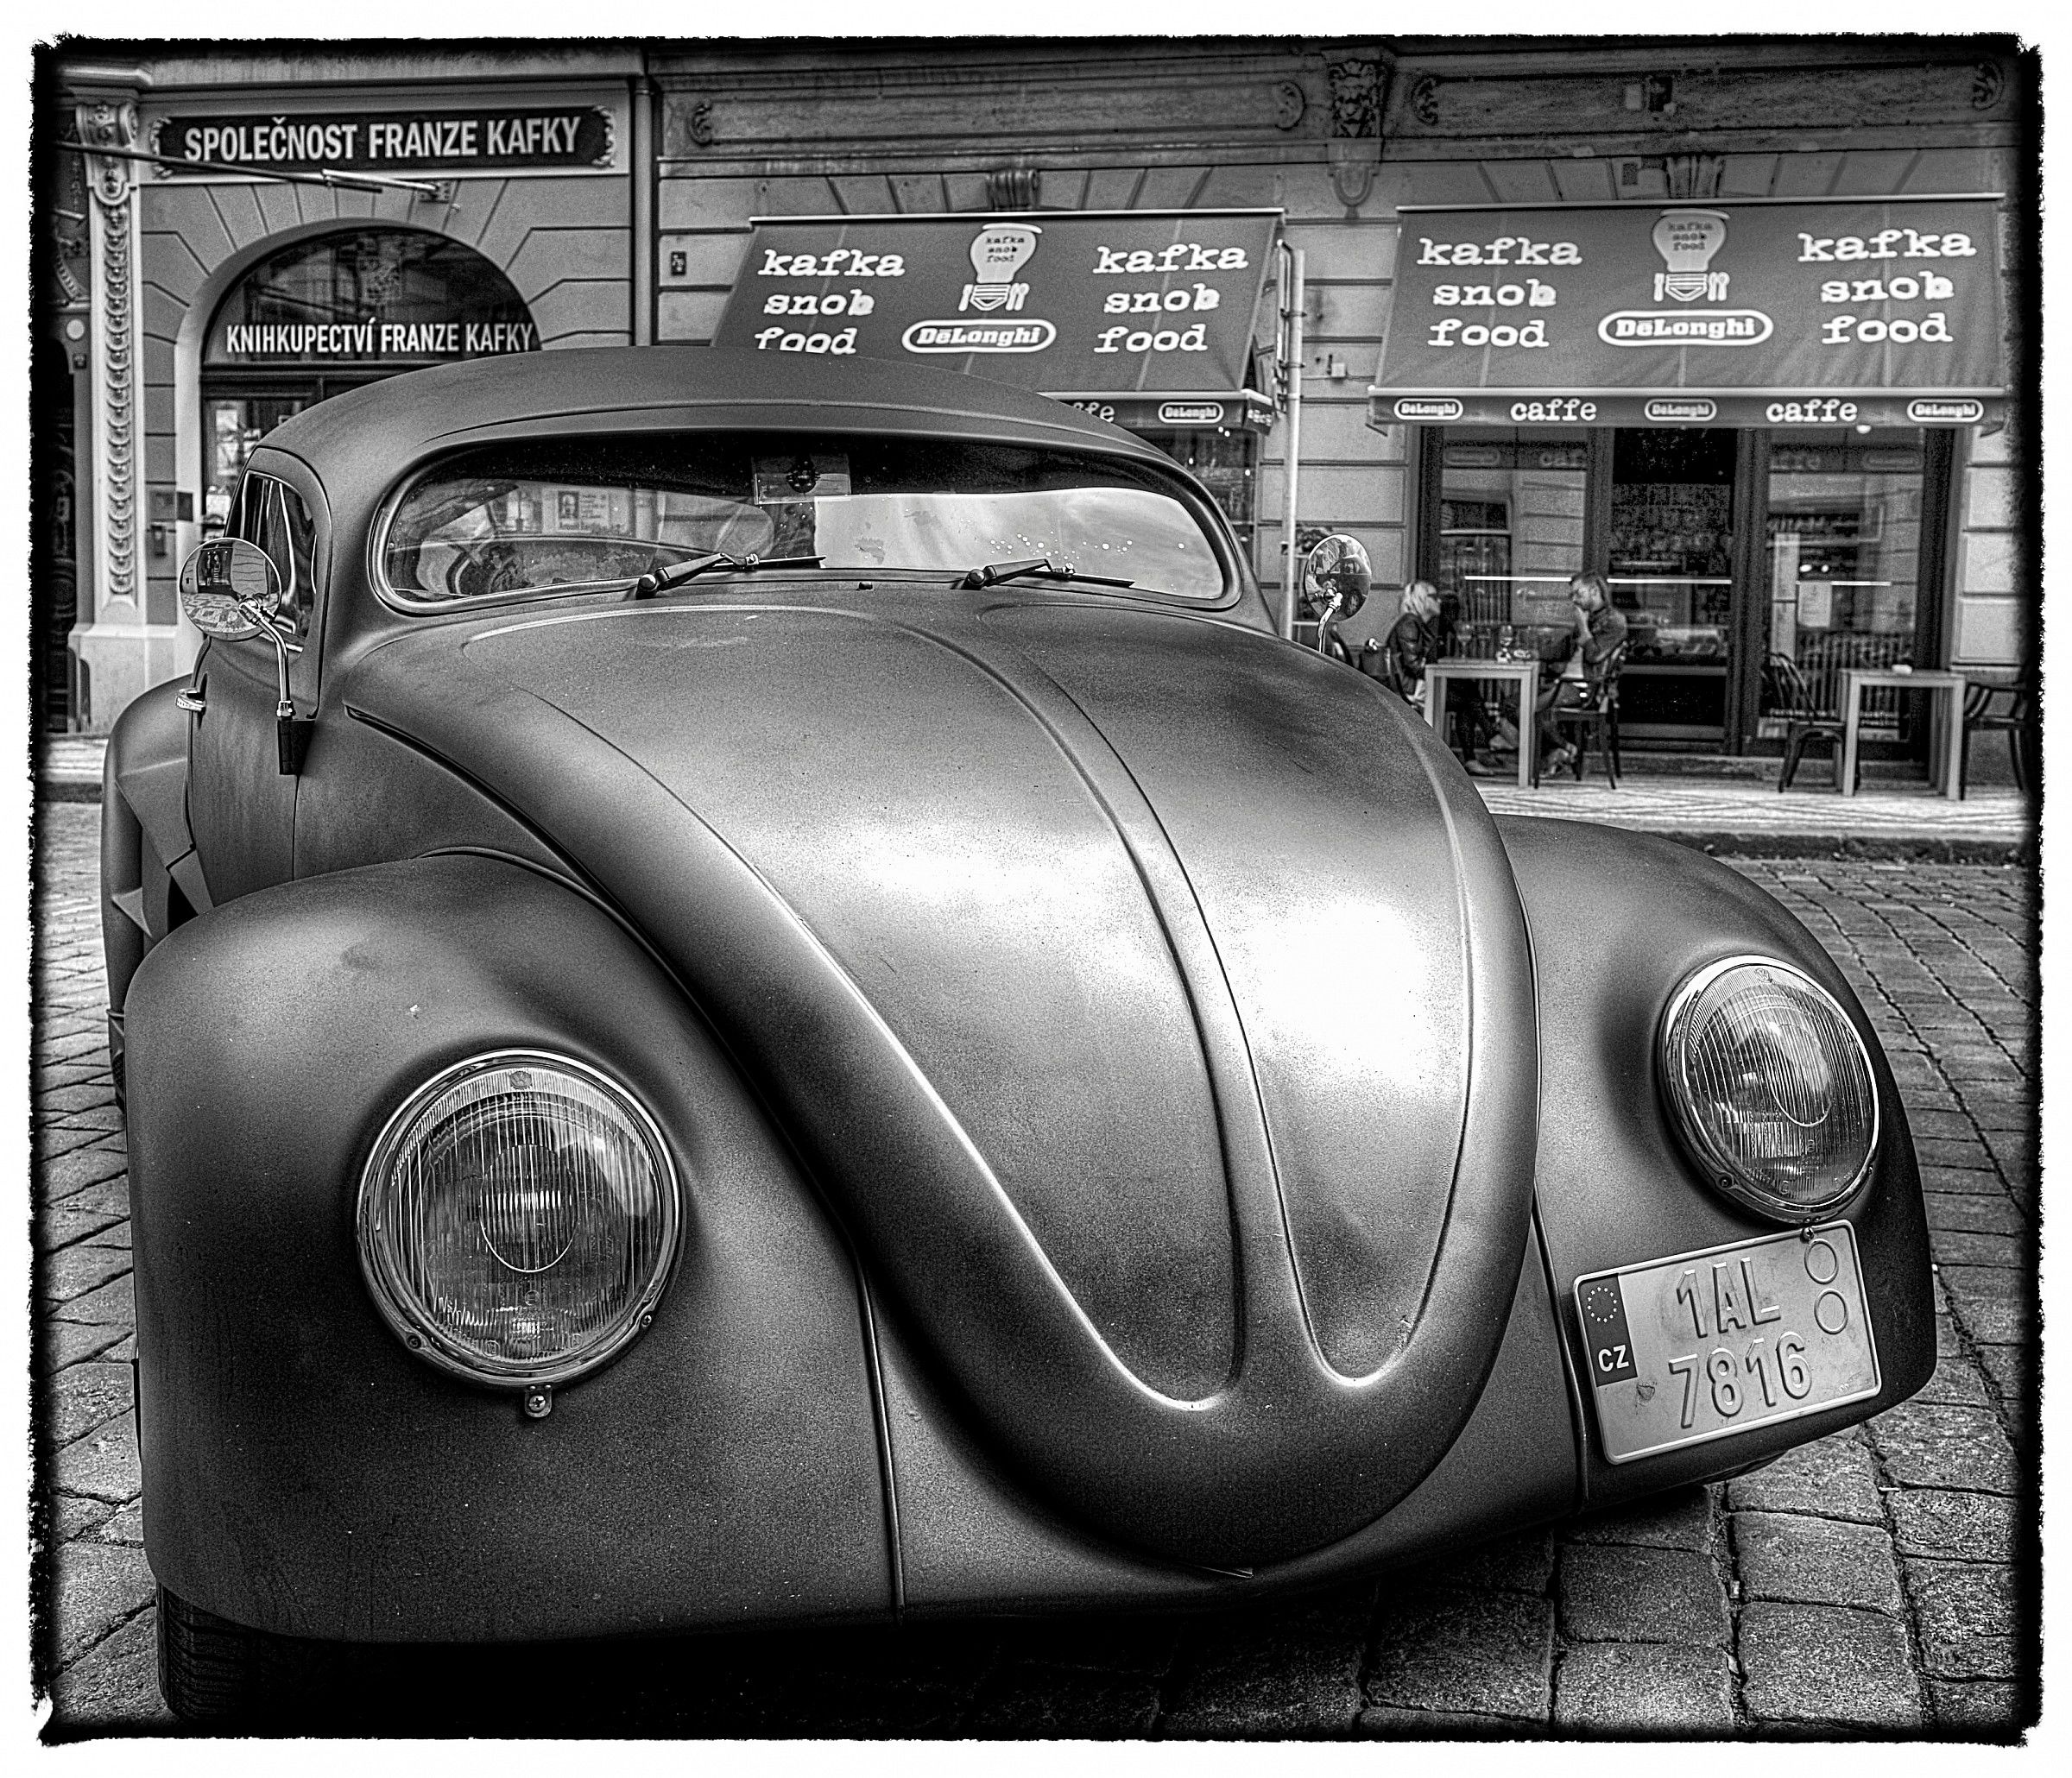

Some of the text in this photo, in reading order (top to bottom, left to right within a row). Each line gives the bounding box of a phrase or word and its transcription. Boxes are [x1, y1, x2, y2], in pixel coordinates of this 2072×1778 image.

[184, 117, 581, 162] SPOLEČNOST FRANZE KAFKY
[1093, 243, 1249, 273] kafka
[1417, 237, 1582, 266] kafka
[1797, 229, 1977, 262] kafka
[757, 249, 906, 276] kafka
[1103, 283, 1221, 313] snob
[1432, 278, 1557, 306] snob
[1821, 270, 1955, 303] snob
[763, 288, 875, 316] snob
[226, 317, 534, 354] KNIHKUPECTVÍ FRANZE KAFKY
[754, 326, 858, 356] food
[1094, 324, 1209, 353] food
[1427, 318, 1551, 347] food
[1822, 312, 1954, 344] food
[1510, 398, 1597, 422] caffe
[1766, 398, 1858, 422] caffe
[1676, 1257, 1782, 1338] 1AL
[1597, 1344, 1630, 1372] CZ
[1668, 1331, 1812, 1429] 7816
